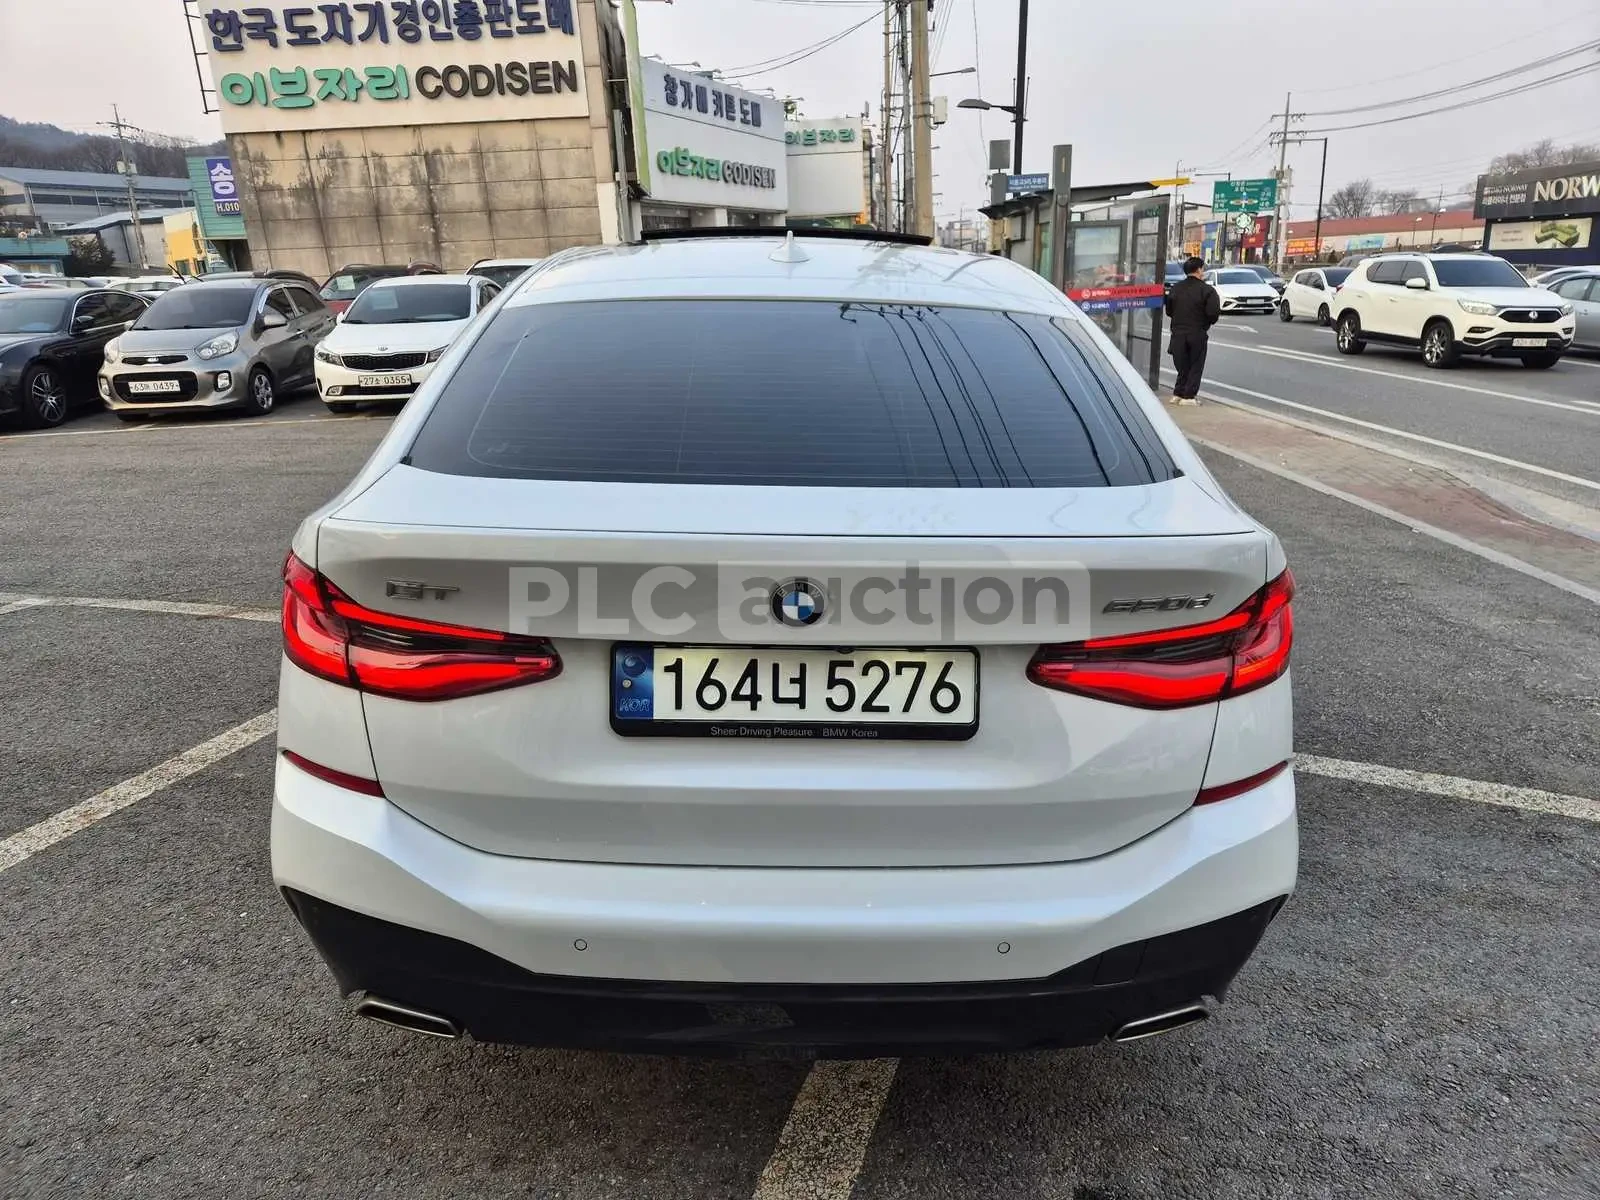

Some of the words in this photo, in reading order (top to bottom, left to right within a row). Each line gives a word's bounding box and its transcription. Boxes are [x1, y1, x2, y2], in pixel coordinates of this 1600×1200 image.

[220, 63, 411, 110] 이브자리
[415, 60, 578, 100] CODISEN
[784, 128, 856, 146] 이브자리
[210, 162, 235, 195] 송
[656, 146, 721, 181] 이브자리
[722, 160, 777, 190] CODISEN
[1532, 174, 1600, 203] NORW
[216, 202, 240, 213] H.010
[383, 375, 407, 384] 0355
[663, 657, 807, 712] 164너
[825, 659, 962, 714] 5276
[710, 726, 738, 737] Sheer
[739, 726, 772, 738] Driving
[773, 727, 814, 738] Pleasure
[822, 727, 849, 738] BMW
[851, 728, 879, 738] Korea
